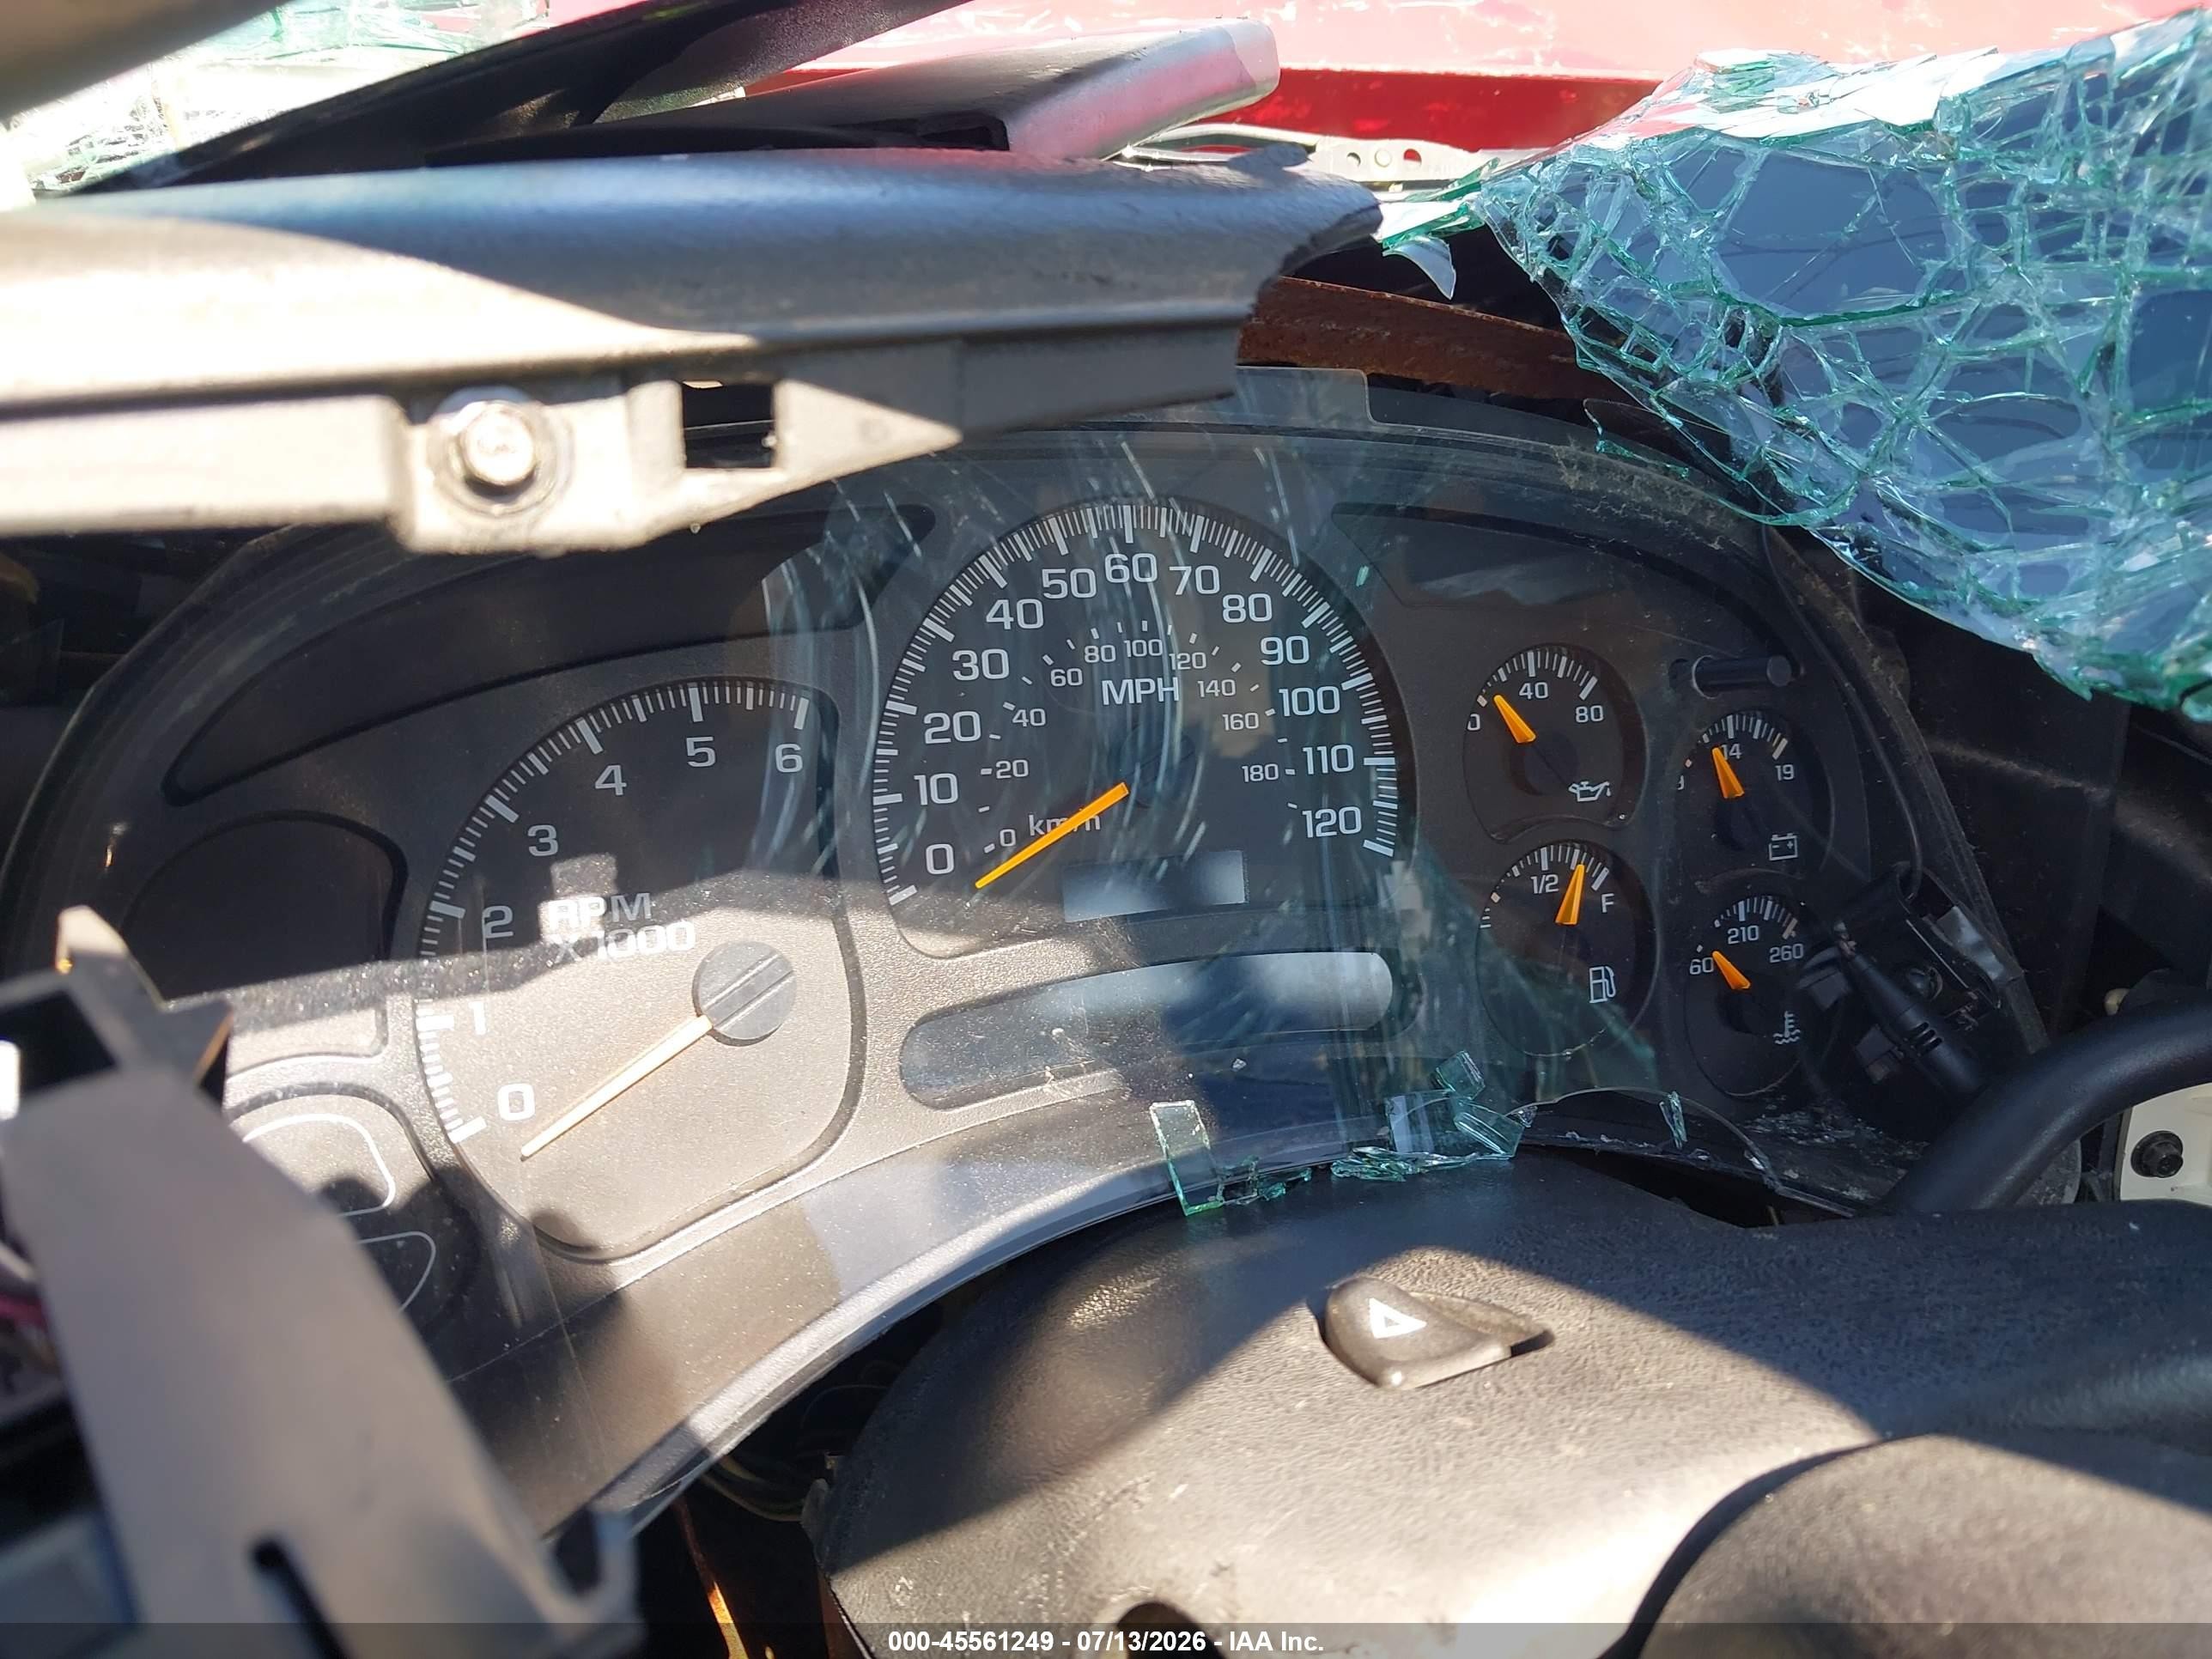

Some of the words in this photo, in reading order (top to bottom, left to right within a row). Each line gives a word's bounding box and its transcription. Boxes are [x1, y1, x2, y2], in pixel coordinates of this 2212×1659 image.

[1105, 553, 1158, 584] 60
[1170, 565, 1219, 595] 70
[1042, 568, 1096, 599] 50
[986, 599, 1043, 629] 40
[1222, 593, 1272, 622] 80
[1084, 644, 1116, 664] 80
[1124, 639, 1163, 657] 100
[1169, 652, 1207, 670] 120
[1261, 635, 1310, 665] 90
[952, 649, 1010, 682] 30
[1050, 668, 1083, 687] 60
[1102, 677, 1179, 704] MPH
[1197, 678, 1236, 697] 140
[1279, 686, 1340, 716] 100
[1519, 682, 1548, 700] 40
[924, 711, 981, 744] 20
[1012, 708, 1046, 726] 40
[1222, 712, 1260, 730] 160
[1575, 705, 1604, 723] 80
[686, 737, 716, 768] 5
[775, 744, 803, 773] 6
[1303, 744, 1354, 774] 110
[1720, 743, 1742, 760] 14
[594, 764, 627, 796] 4
[995, 759, 1029, 779] 20
[1242, 763, 1279, 782] 180
[1775, 764, 1795, 781] 19
[914, 773, 959, 805] 10
[1302, 805, 1361, 838] 120
[527, 824, 558, 857] 3
[999, 829, 1017, 847] 0
[926, 843, 954, 874] 0
[1530, 874, 1559, 894] 1/2
[547, 892, 653, 929] RPM
[1601, 893, 1615, 914] F
[483, 905, 514, 939] 2
[1727, 925, 1759, 945] 210
[590, 920, 696, 961] 1000
[1769, 943, 1804, 963] 260
[1689, 957, 1715, 975] 60
[468, 1001, 486, 1036] 1
[496, 1084, 536, 1121] 0
